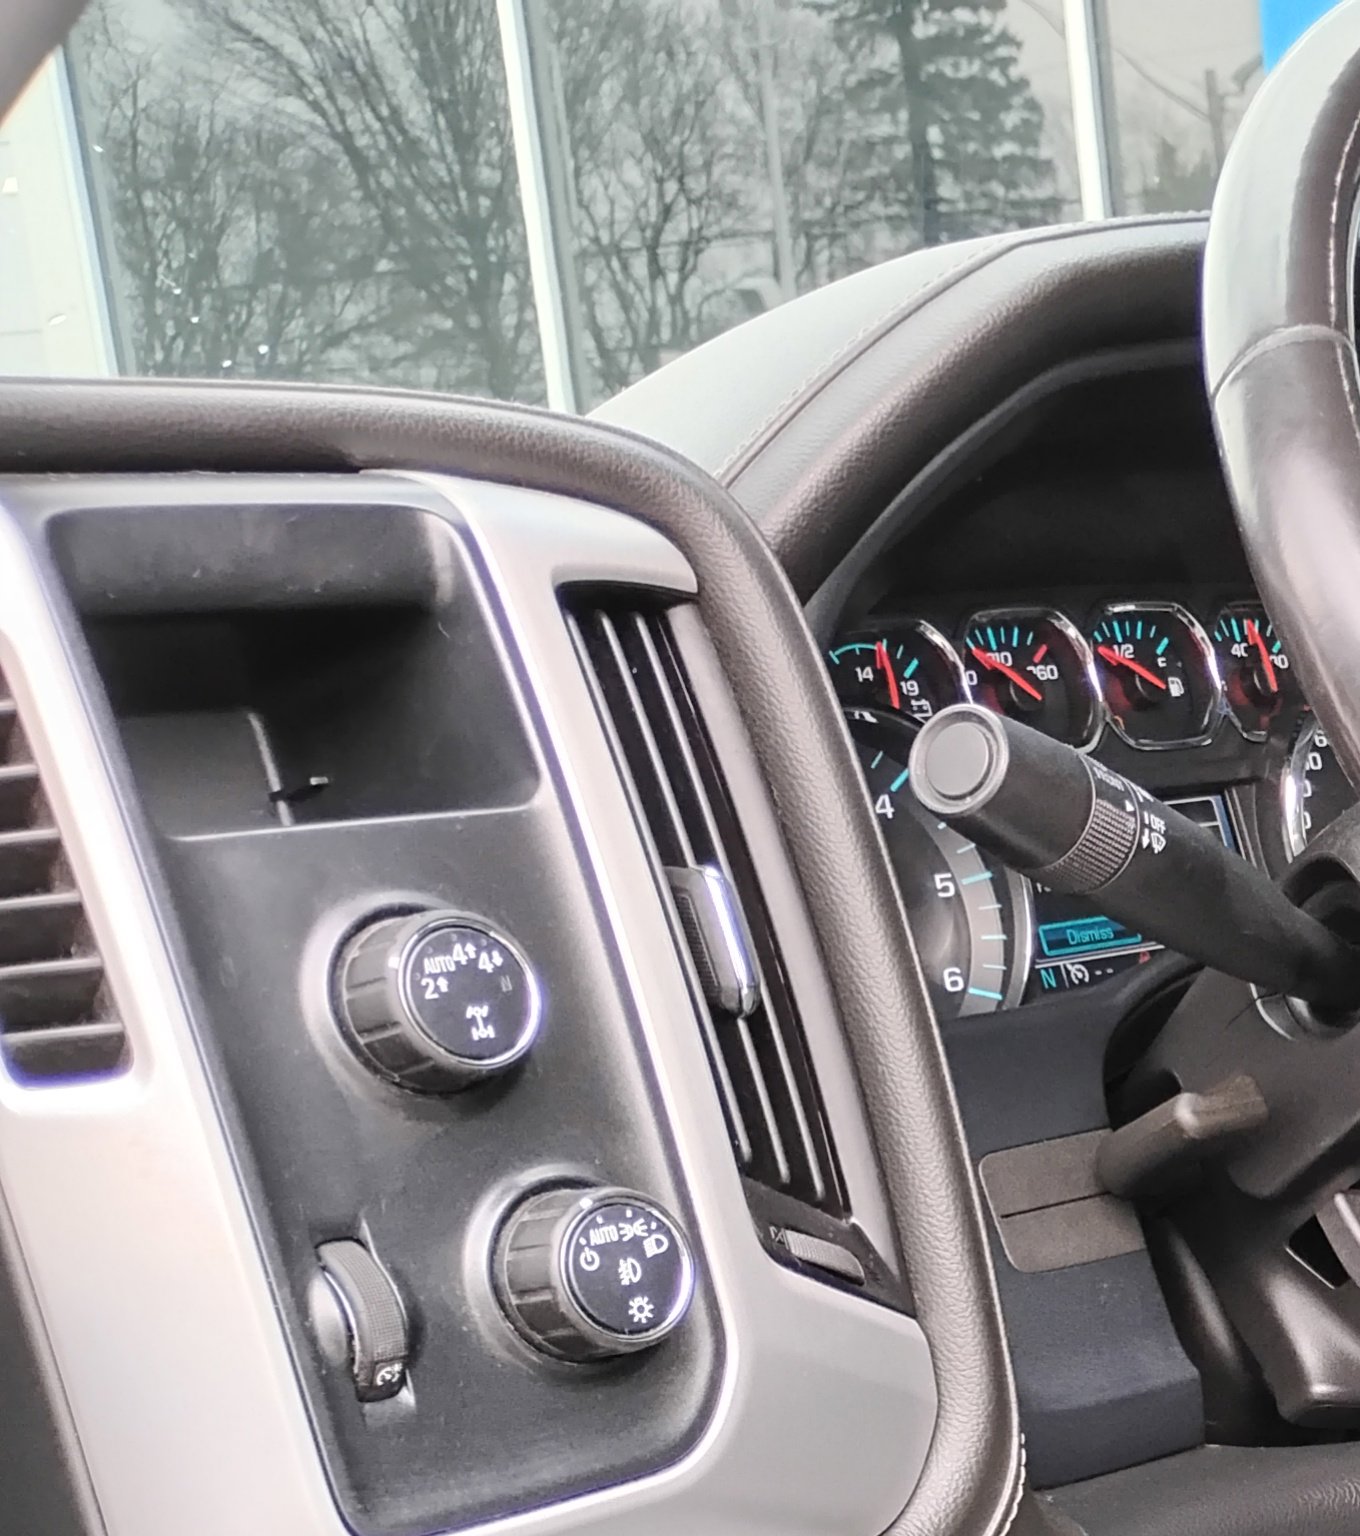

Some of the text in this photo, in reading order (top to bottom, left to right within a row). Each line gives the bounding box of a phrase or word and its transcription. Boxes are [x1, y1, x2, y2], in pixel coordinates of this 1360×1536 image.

[854, 667, 874, 682] 14
[901, 680, 919, 696] 19
[875, 794, 895, 819] 4
[1150, 813, 1166, 834] OFF
[934, 873, 956, 897] 5
[1067, 926, 1114, 945] Dismiss
[452, 943, 468, 965] 4
[478, 951, 494, 973] 4
[423, 955, 456, 975] AUTO
[421, 978, 439, 999] 2
[943, 967, 964, 992] 6
[1041, 968, 1057, 989] N
[589, 1224, 620, 1246] AUTO
